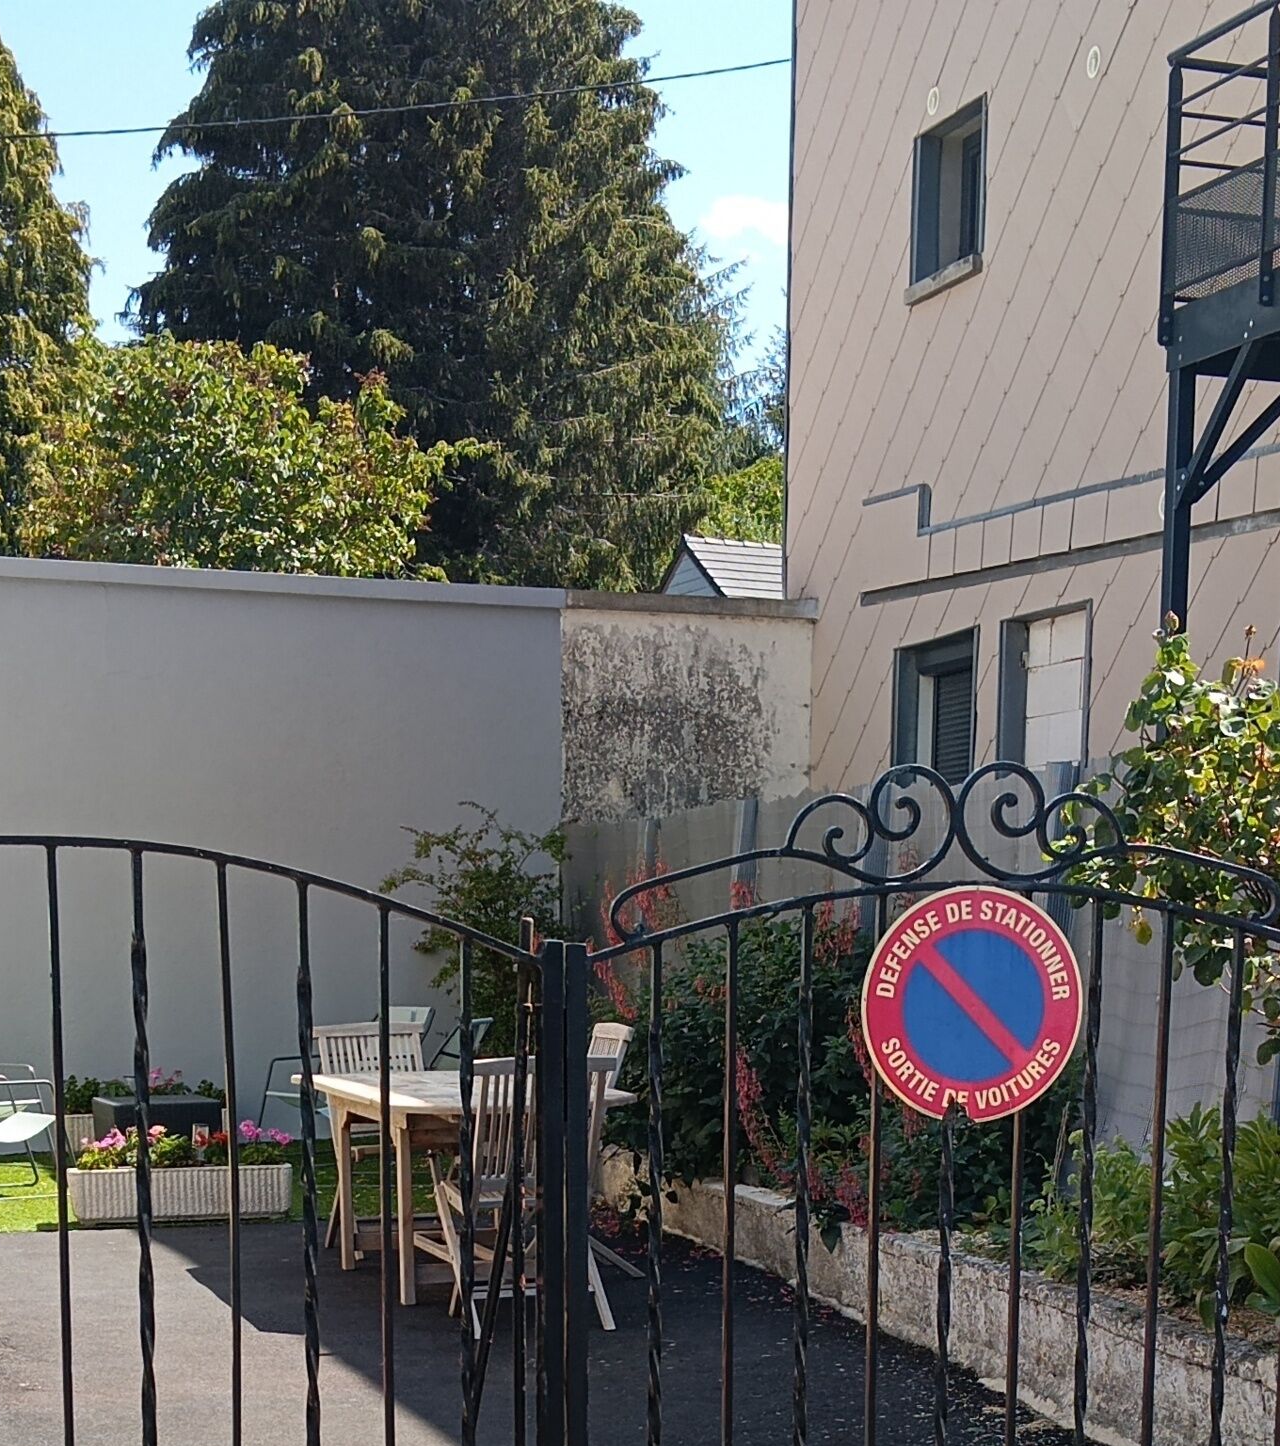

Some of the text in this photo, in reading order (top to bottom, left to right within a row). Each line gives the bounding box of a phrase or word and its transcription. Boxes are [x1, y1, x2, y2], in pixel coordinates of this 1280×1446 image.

[876, 900, 1070, 1000] DEFENSE DE STATIONNER
[881, 1037, 940, 1102] SORTIE
[974, 1038, 1061, 1110] VOITURES
